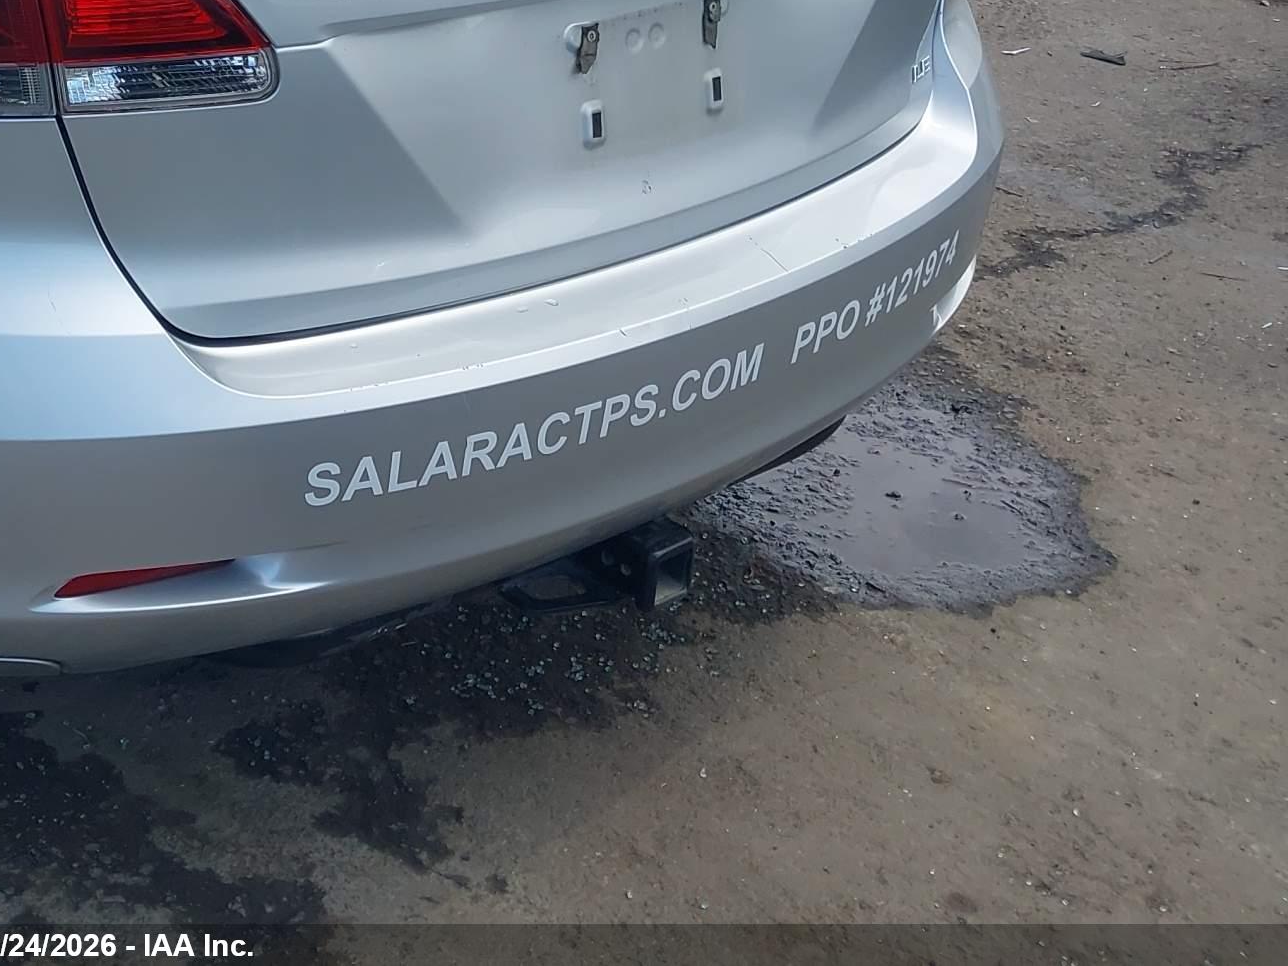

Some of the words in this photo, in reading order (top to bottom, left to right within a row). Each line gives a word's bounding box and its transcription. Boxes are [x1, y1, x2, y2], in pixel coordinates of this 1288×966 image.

[304, 343, 764, 507] SALARACTPS.COM
[791, 307, 860, 365] PPO
[864, 230, 961, 326] #121974
